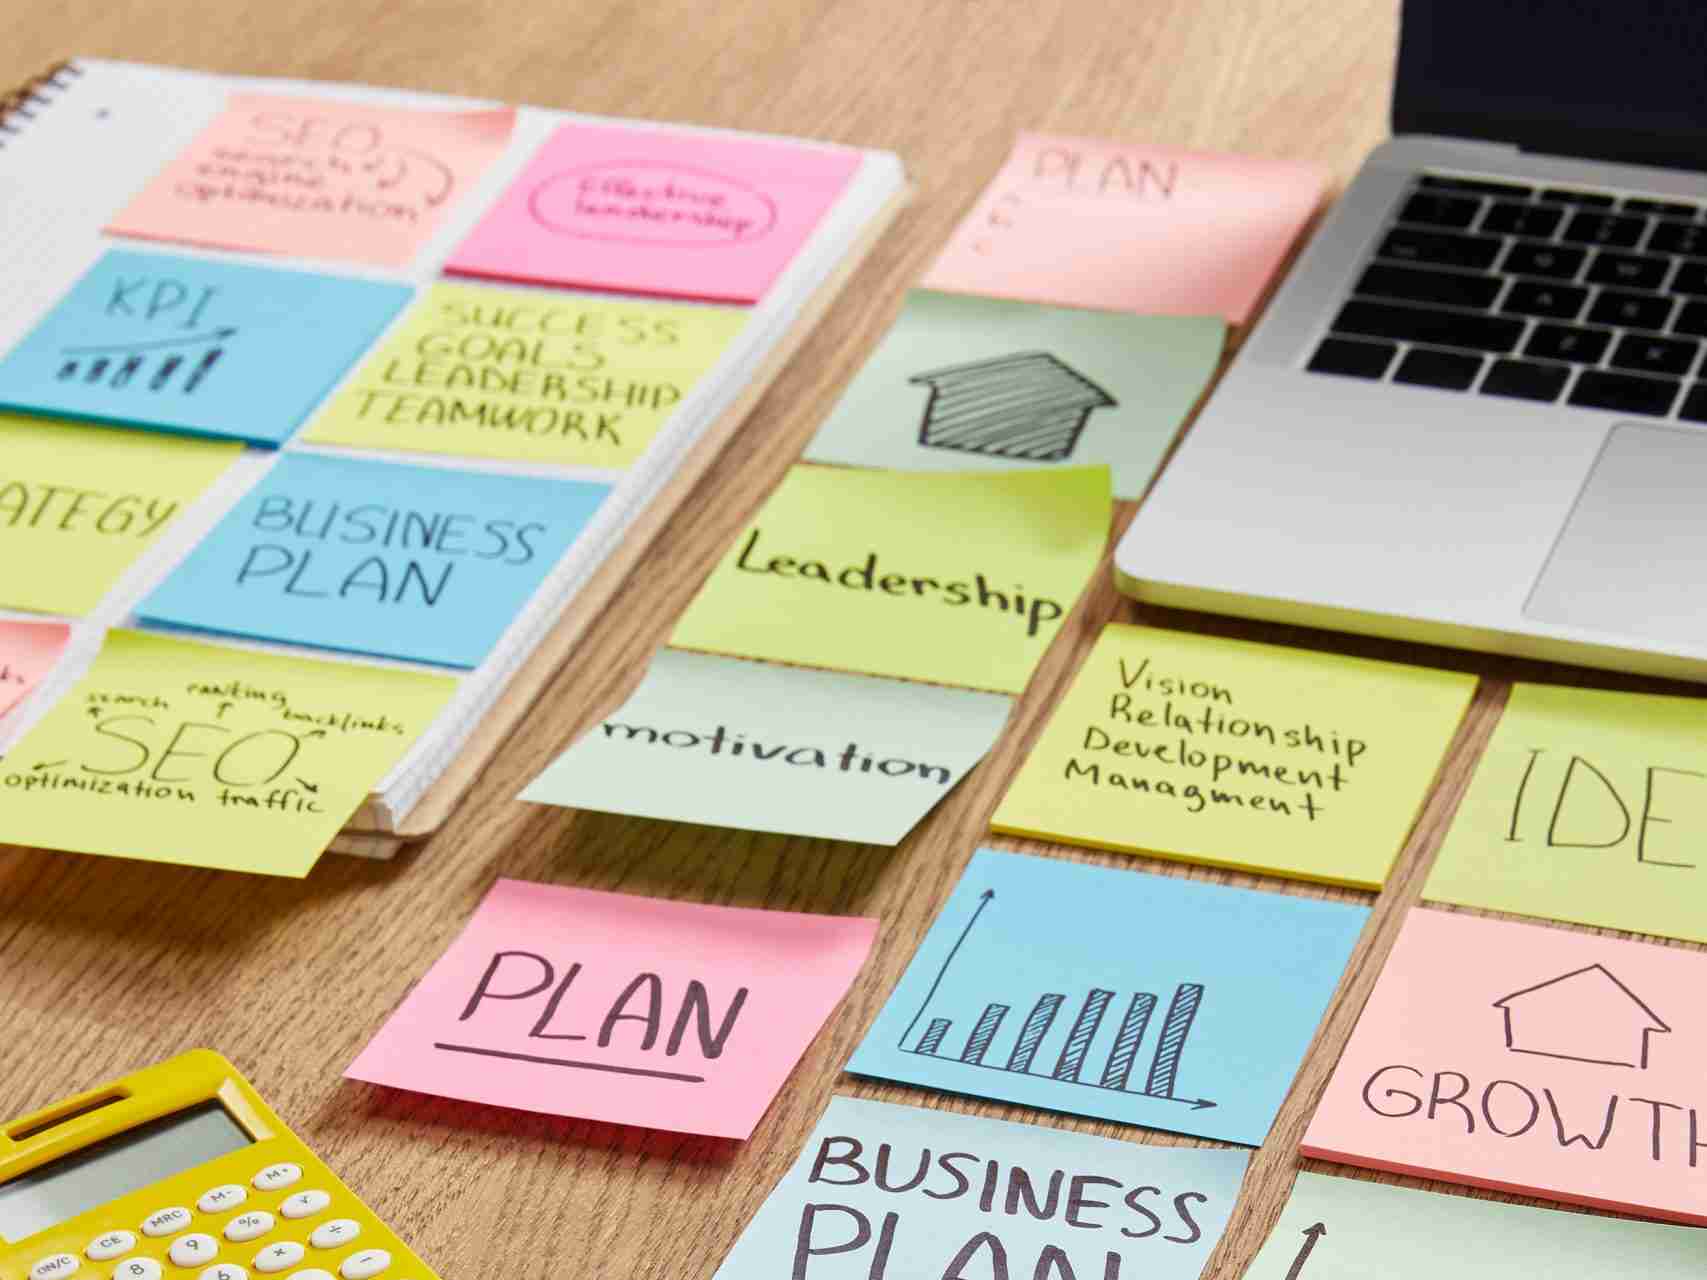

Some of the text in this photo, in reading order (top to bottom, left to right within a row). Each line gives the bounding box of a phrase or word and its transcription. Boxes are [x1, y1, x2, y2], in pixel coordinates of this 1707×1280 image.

[104, 276, 222, 329] KPI
[443, 302, 680, 348] SUCCESS
[414, 333, 606, 370] GOALS
[381, 359, 682, 410] LEADERSHIP
[355, 390, 622, 447] TEAMWORK
[252, 496, 547, 565] BUSINESS
[235, 544, 453, 607] PLAN
[735, 529, 1063, 637] Leadership
[1119, 657, 1234, 706] Vision
[80, 715, 300, 787] SEO
[601, 720, 953, 786] motivation
[1109, 692, 1367, 767] Relationship
[1083, 725, 1350, 792] Development
[4, 770, 325, 814] optimization traffic
[1063, 757, 1326, 822] Managment
[1503, 746, 1707, 870] IDE
[457, 949, 750, 1061] PLAN
[150, 1209, 183, 1228] MRC
[807, 1135, 1209, 1245] BUSINESS
[36, 1255, 72, 1276] ON/C
[99, 1236, 122, 1249] CE
[129, 1263, 145, 1277] 8
[185, 1238, 200, 1252] 9
